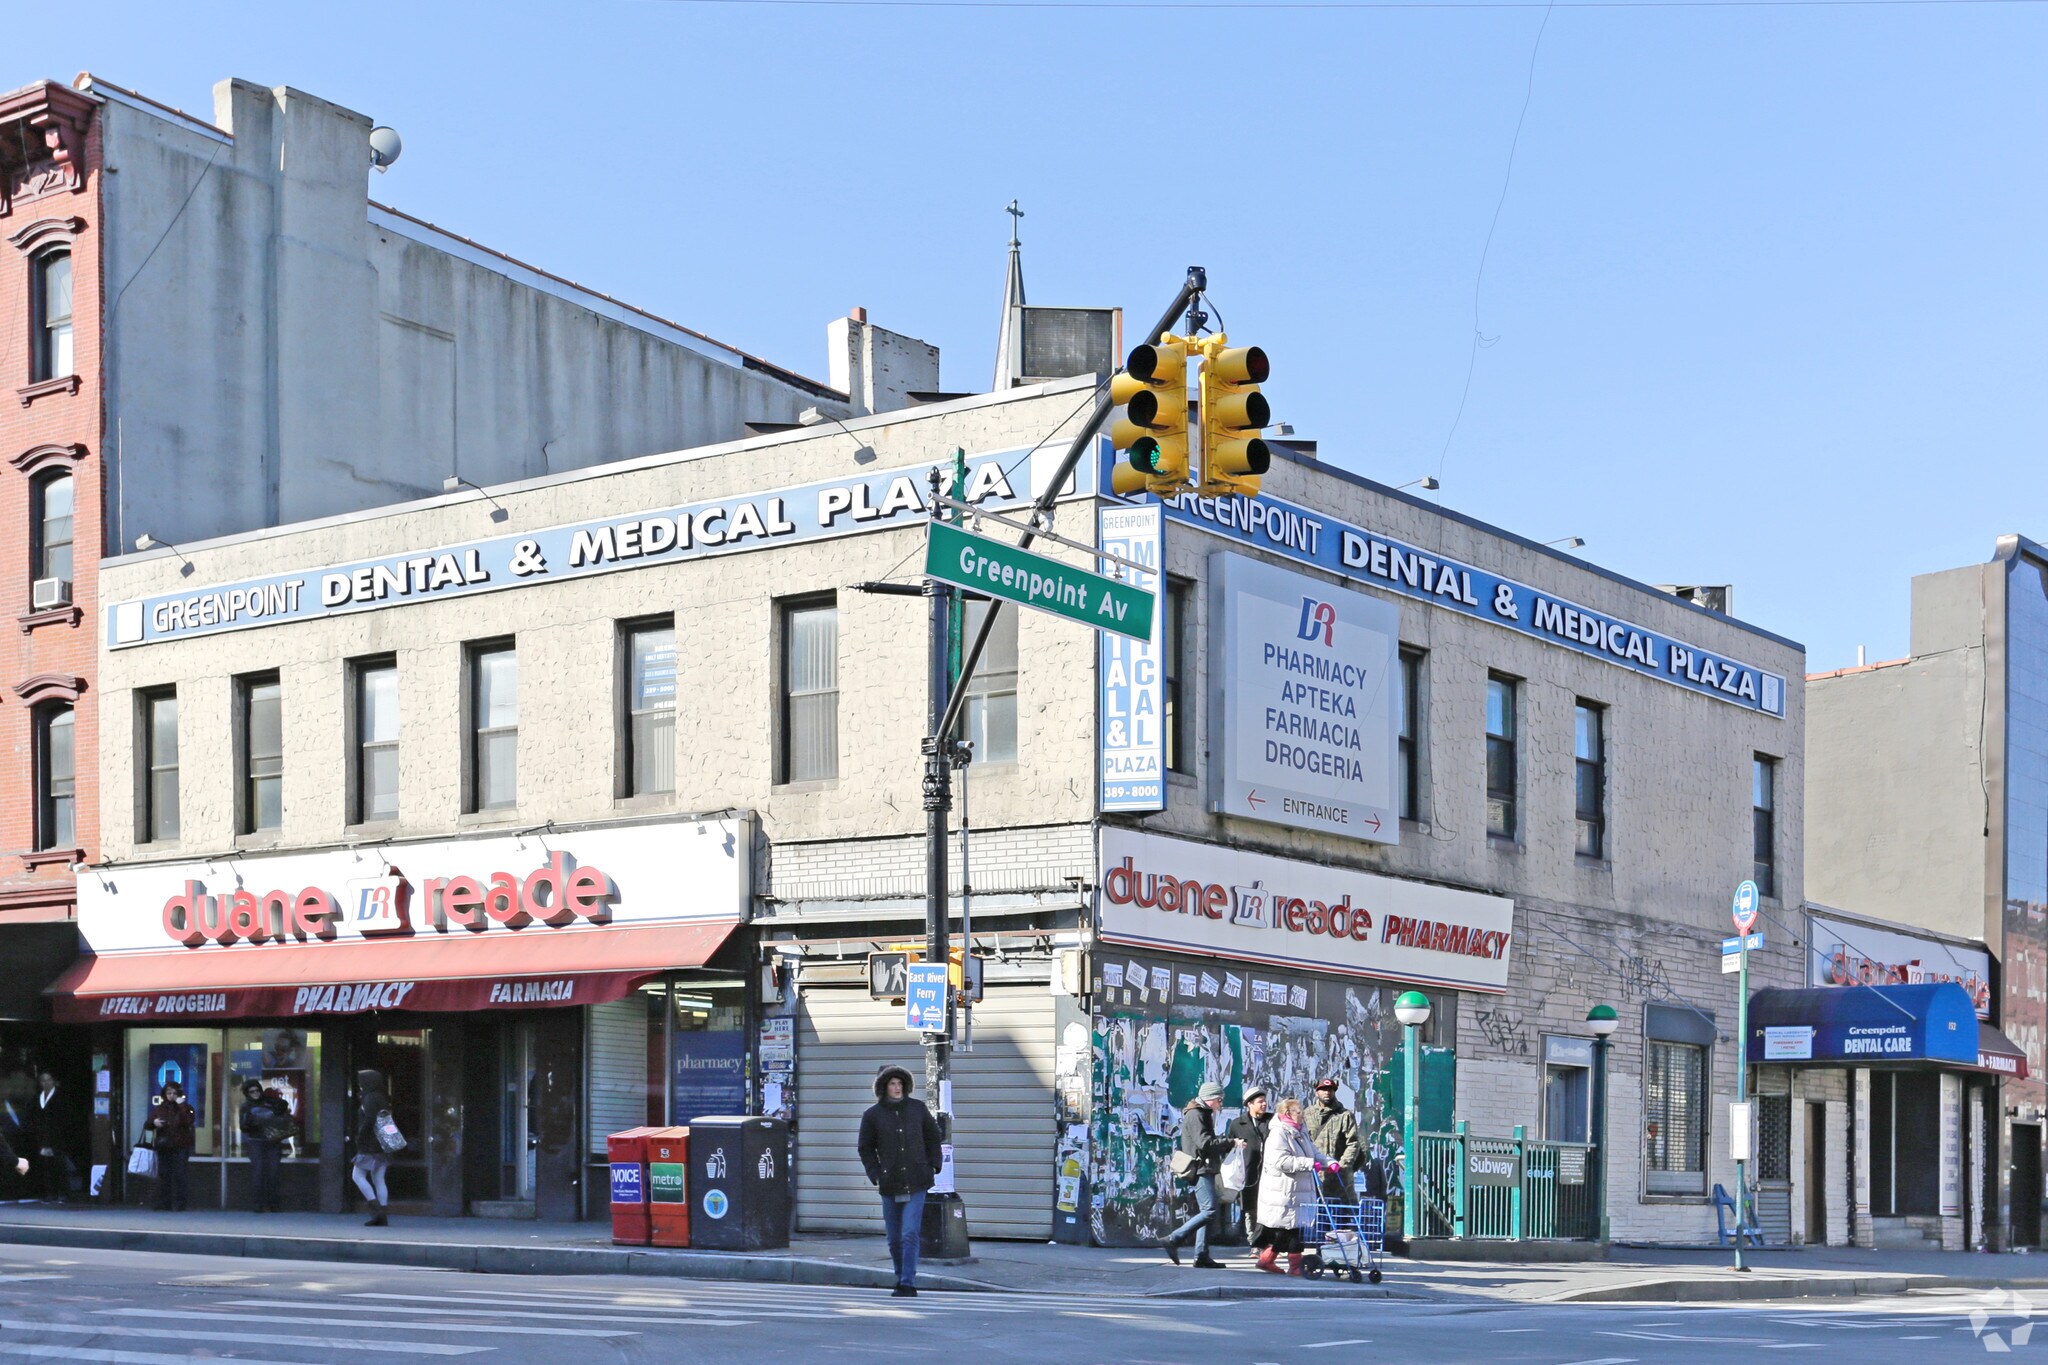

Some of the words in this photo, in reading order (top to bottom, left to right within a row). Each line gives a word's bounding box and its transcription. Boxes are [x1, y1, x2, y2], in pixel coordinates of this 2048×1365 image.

[1103, 513, 1156, 530] GREENPOINT
[152, 580, 303, 633] GREENPOINT
[321, 548, 488, 606] DENTAL
[508, 539, 546, 577] &
[569, 497, 794, 568] MEDICAL
[818, 461, 1016, 527] PLAZA
[959, 546, 1088, 610] Greenpoint
[1097, 591, 1129, 622] Av
[1297, 596, 1336, 648] DR
[1342, 530, 1478, 607] DENTAL
[1494, 584, 1519, 620] &
[1535, 597, 1659, 669] MEDICAL
[1670, 644, 1756, 701] PLAZA
[1263, 642, 1367, 690] PHARMACY
[1281, 680, 1357, 719] APTEKA
[1265, 706, 1362, 752] FARMACIA
[1105, 756, 1157, 774] PLAZA
[1265, 739, 1364, 783] DROGERIA
[1105, 785, 1158, 798] 389-8000
[1283, 797, 1348, 824] ENTRANCE
[163, 879, 337, 942] duane
[357, 886, 391, 920] DR
[423, 850, 613, 928] reade
[1106, 856, 1228, 919] duane
[1273, 895, 1372, 941] reade
[1382, 914, 1510, 960] PHARMACY
[909, 972, 924, 983] East
[927, 972, 945, 984] River
[293, 981, 414, 1013] PHARMACY
[489, 980, 574, 1003] FARMACIA
[916, 988, 936, 1002] Ferry
[100, 997, 149, 1015] APTEKA
[155, 993, 226, 1013] DROGERIA
[1849, 1025, 1906, 1036] Greenpoint
[1844, 1037, 1882, 1054] DENTAL
[1884, 1036, 1912, 1053] CARE
[677, 1054, 742, 1074] pharmacy
[1989, 1055, 2017, 1073] FARMACIA
[271, 1075, 289, 1089] get
[613, 1168, 640, 1183] VOICE
[1470, 1157, 1514, 1178] Subway
[653, 1174, 682, 1186] metro
